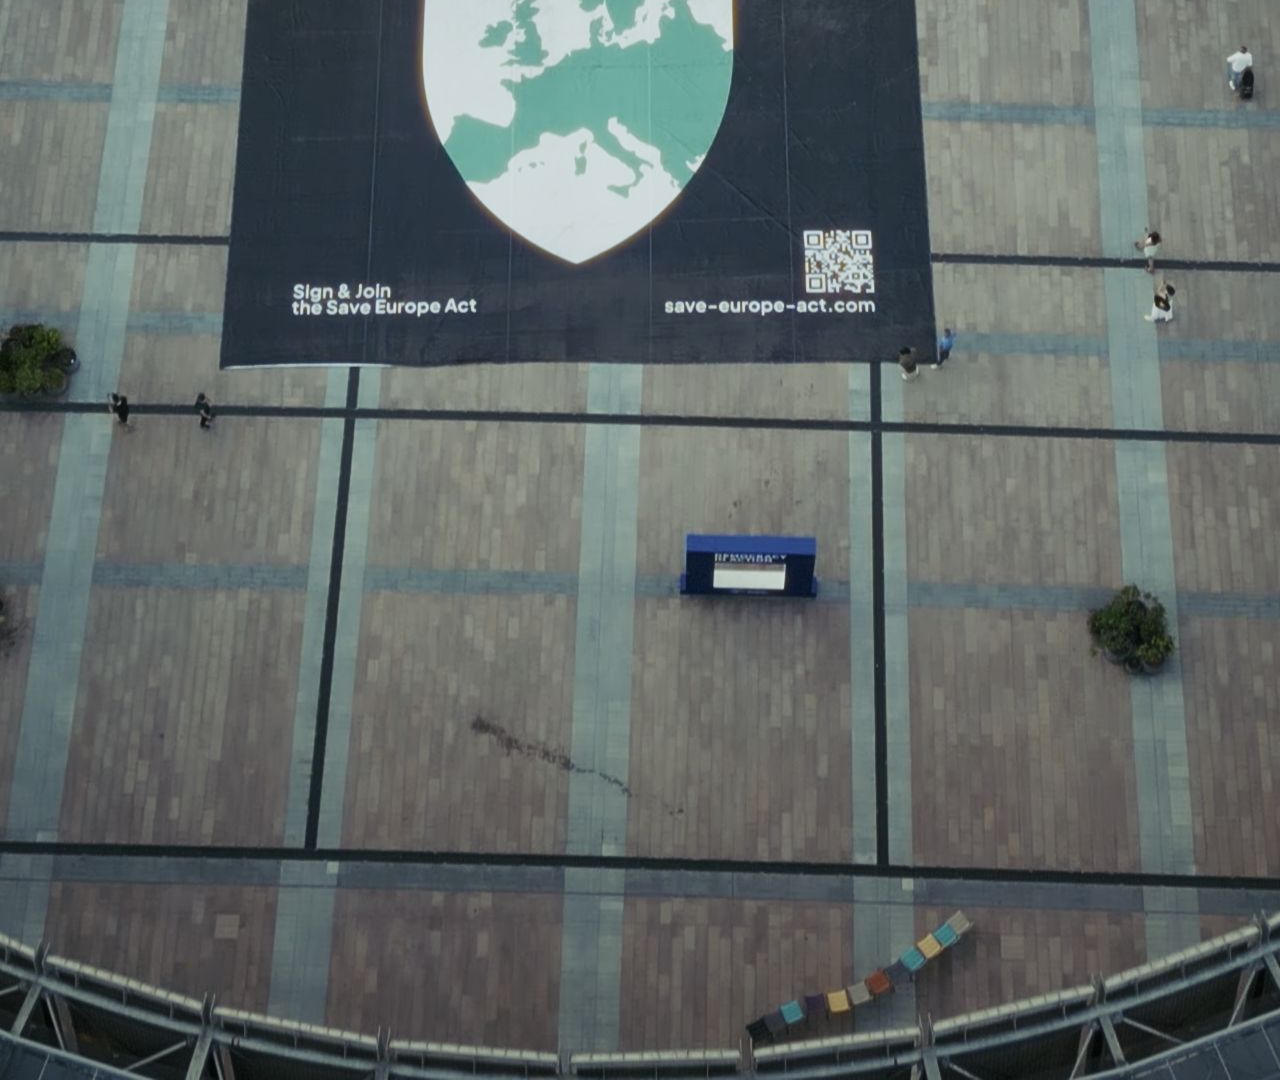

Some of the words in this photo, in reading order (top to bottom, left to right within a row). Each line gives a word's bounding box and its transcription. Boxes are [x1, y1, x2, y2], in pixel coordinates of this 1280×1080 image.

[293, 284, 333, 302] Sign
[337, 283, 350, 299] &
[356, 283, 391, 298] Join
[292, 301, 322, 315] the
[326, 300, 371, 315] Save
[375, 299, 441, 317] Europe
[445, 298, 477, 313] Act
[664, 299, 875, 316] save-europe-act.com
